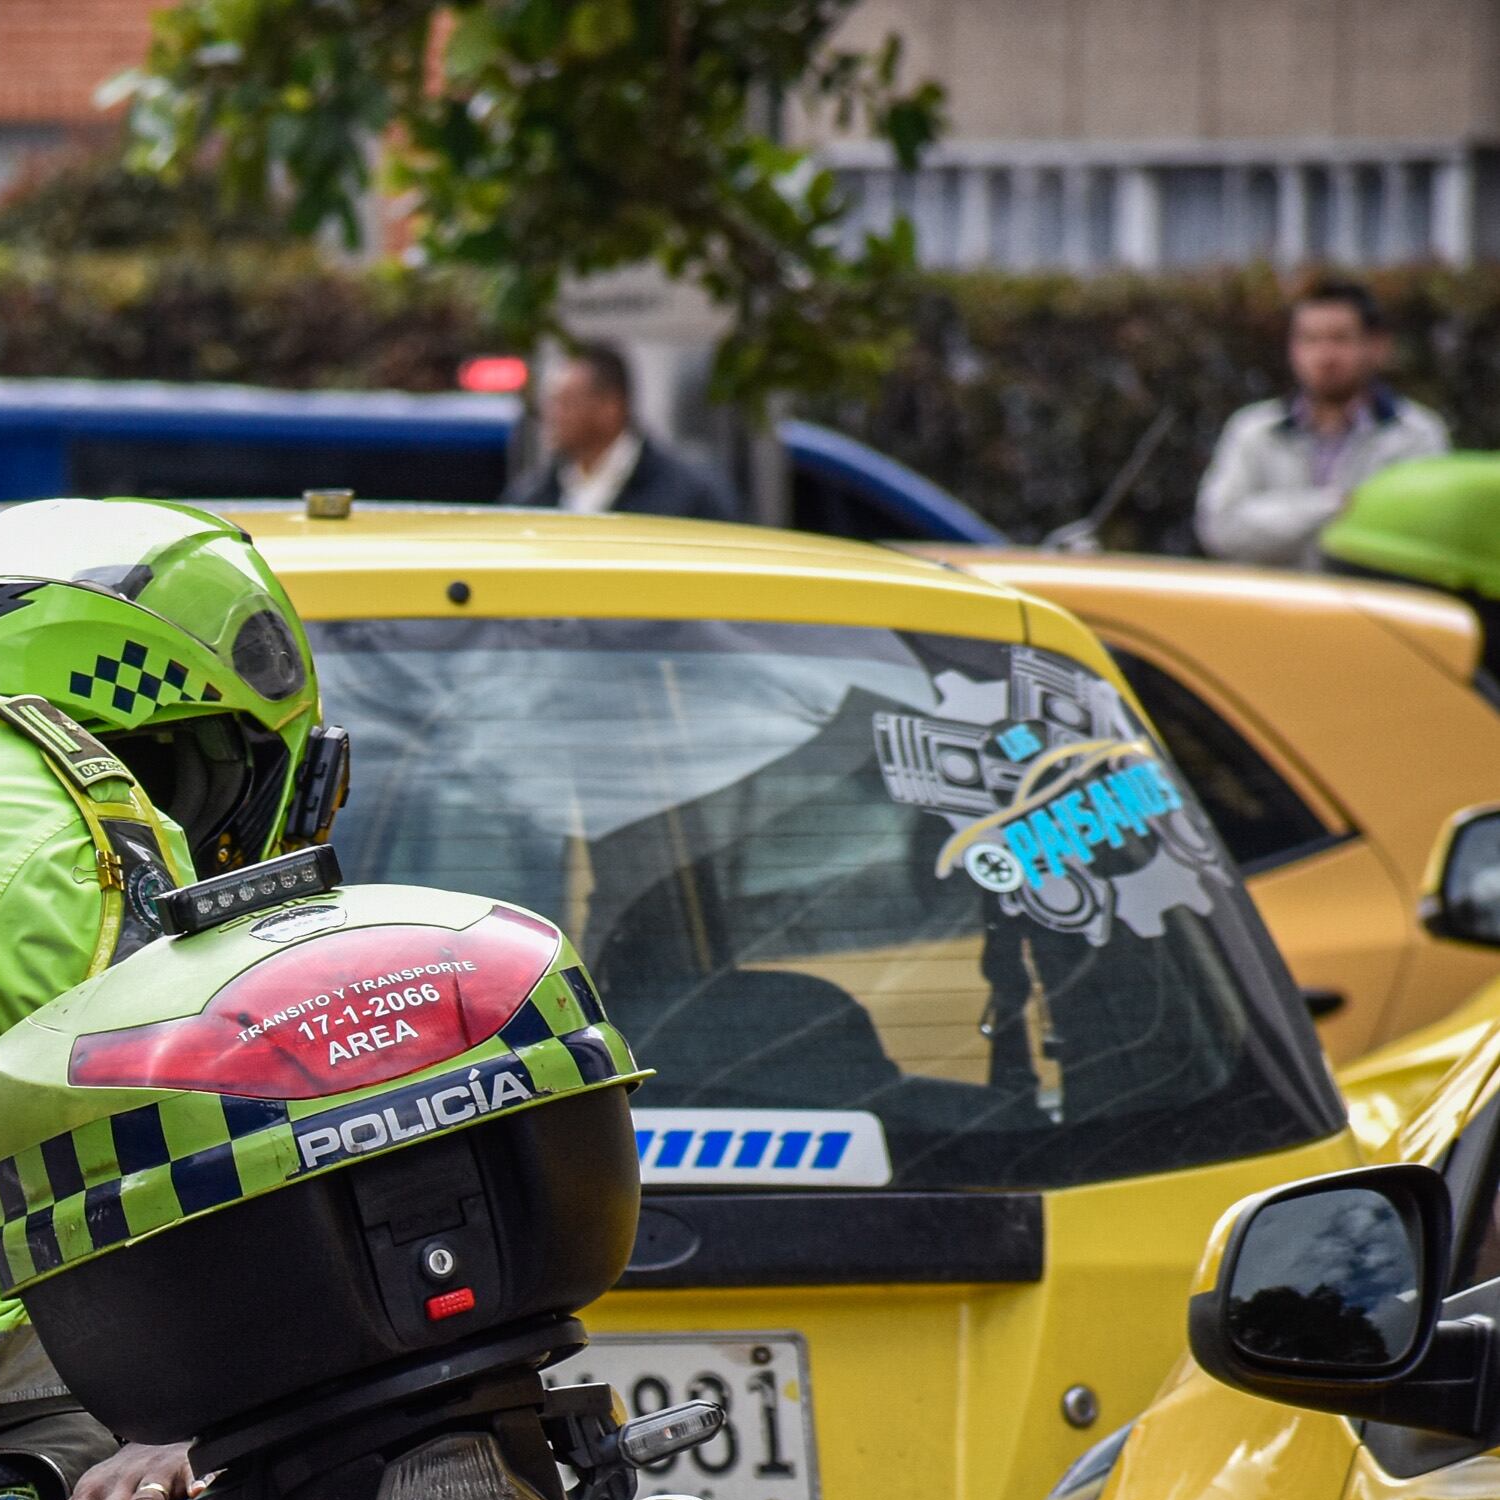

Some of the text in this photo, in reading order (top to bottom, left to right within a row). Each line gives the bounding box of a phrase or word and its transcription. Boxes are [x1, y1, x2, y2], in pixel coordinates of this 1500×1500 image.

[237, 960, 477, 1042] TRANSITO Y TRANSPORTE
[298, 983, 440, 1040] 17-1-2066
[328, 1019, 419, 1065] AREA
[298, 1068, 533, 1168] POLICÍA
[545, 1369, 796, 1480] 881
